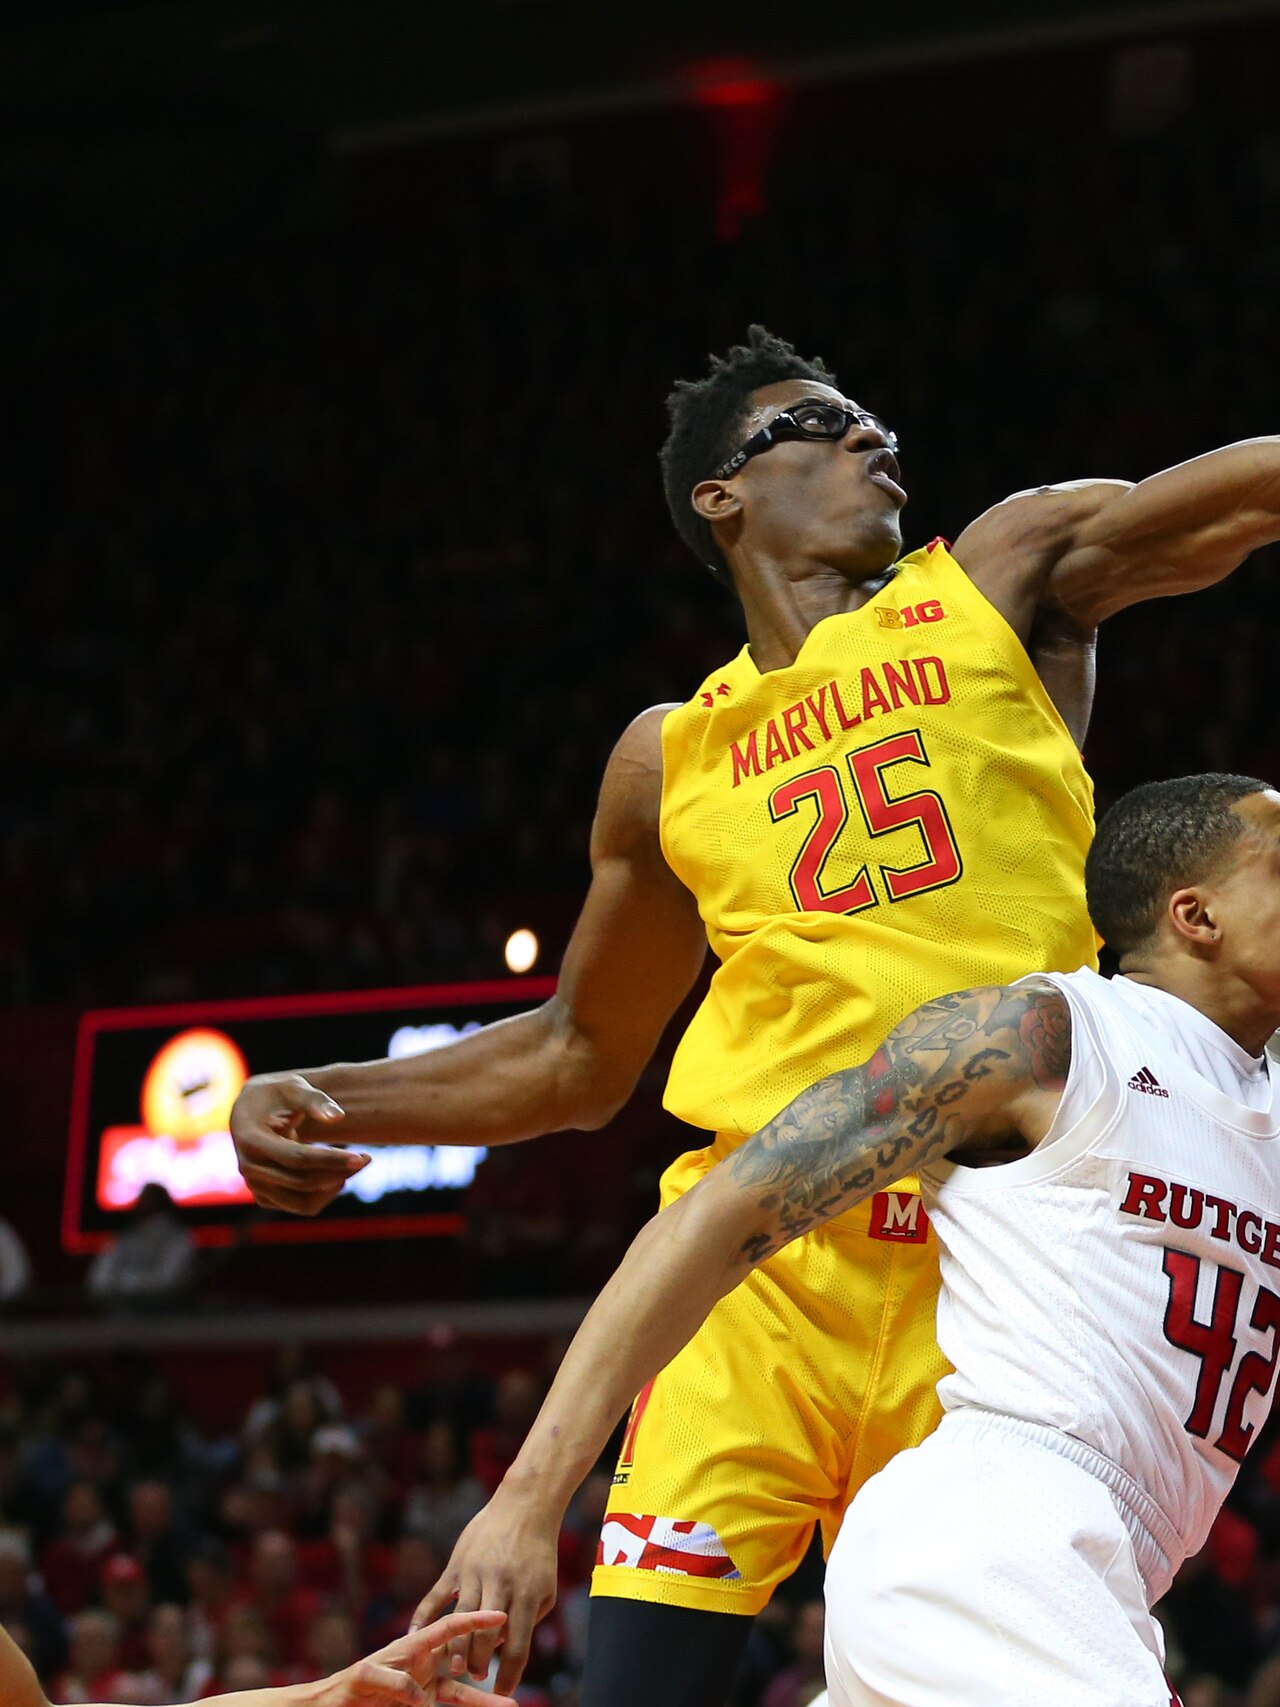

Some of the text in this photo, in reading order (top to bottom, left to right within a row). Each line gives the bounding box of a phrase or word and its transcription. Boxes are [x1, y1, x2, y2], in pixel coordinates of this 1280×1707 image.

[729, 656, 951, 788] MARYLAND
[768, 728, 963, 916] 25
[1127, 1078, 1169, 1099] adidas
[882, 1192, 921, 1230] M
